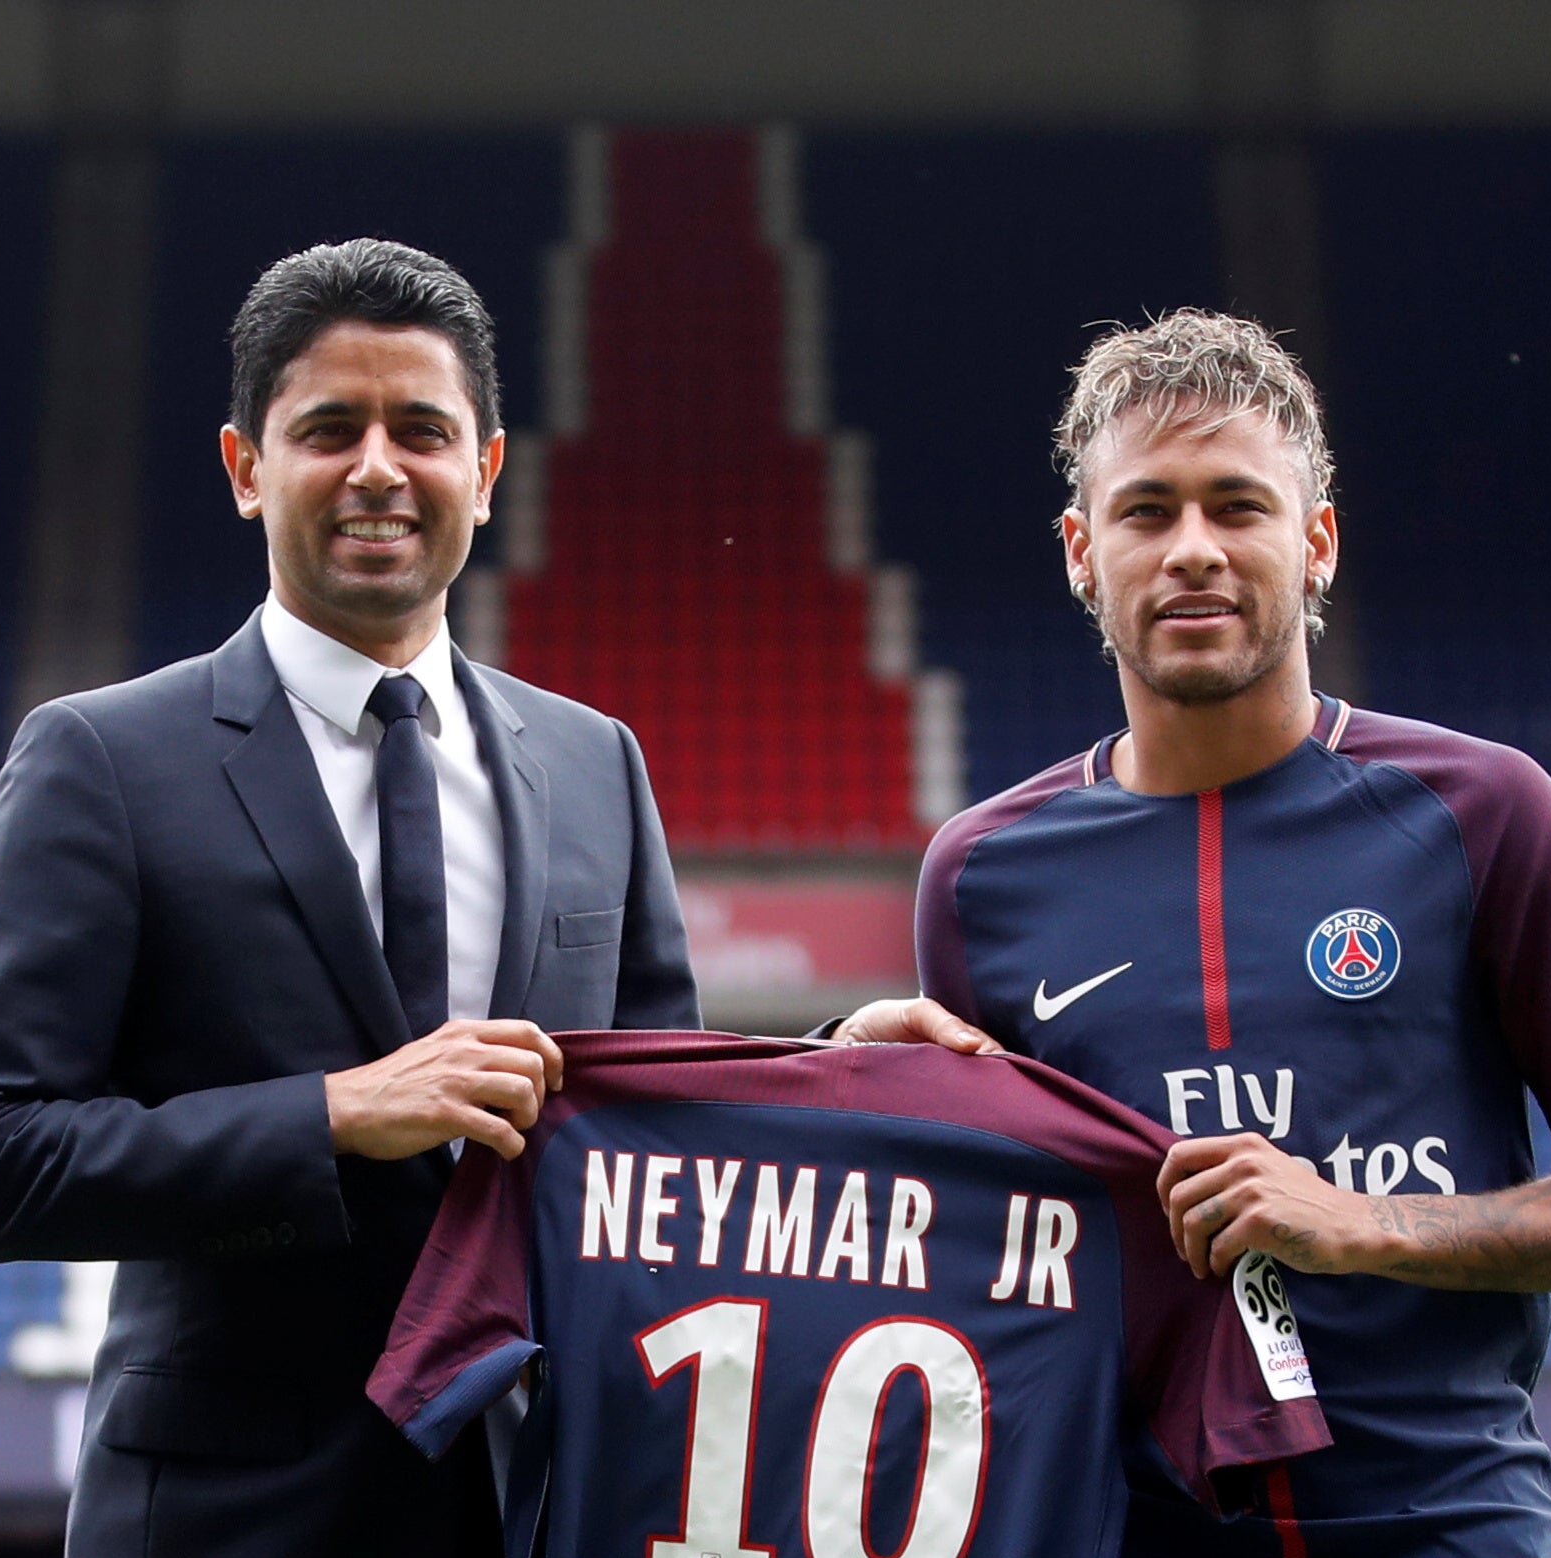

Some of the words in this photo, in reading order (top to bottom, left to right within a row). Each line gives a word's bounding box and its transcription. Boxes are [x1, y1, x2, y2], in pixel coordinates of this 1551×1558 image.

[1320, 913, 1382, 939] PARIS
[1162, 1064, 1294, 1140] Fly
[579, 1146, 935, 1292] NEYMAR
[989, 1192, 1080, 1311] JR
[1267, 1338, 1301, 1354] LIGUE
